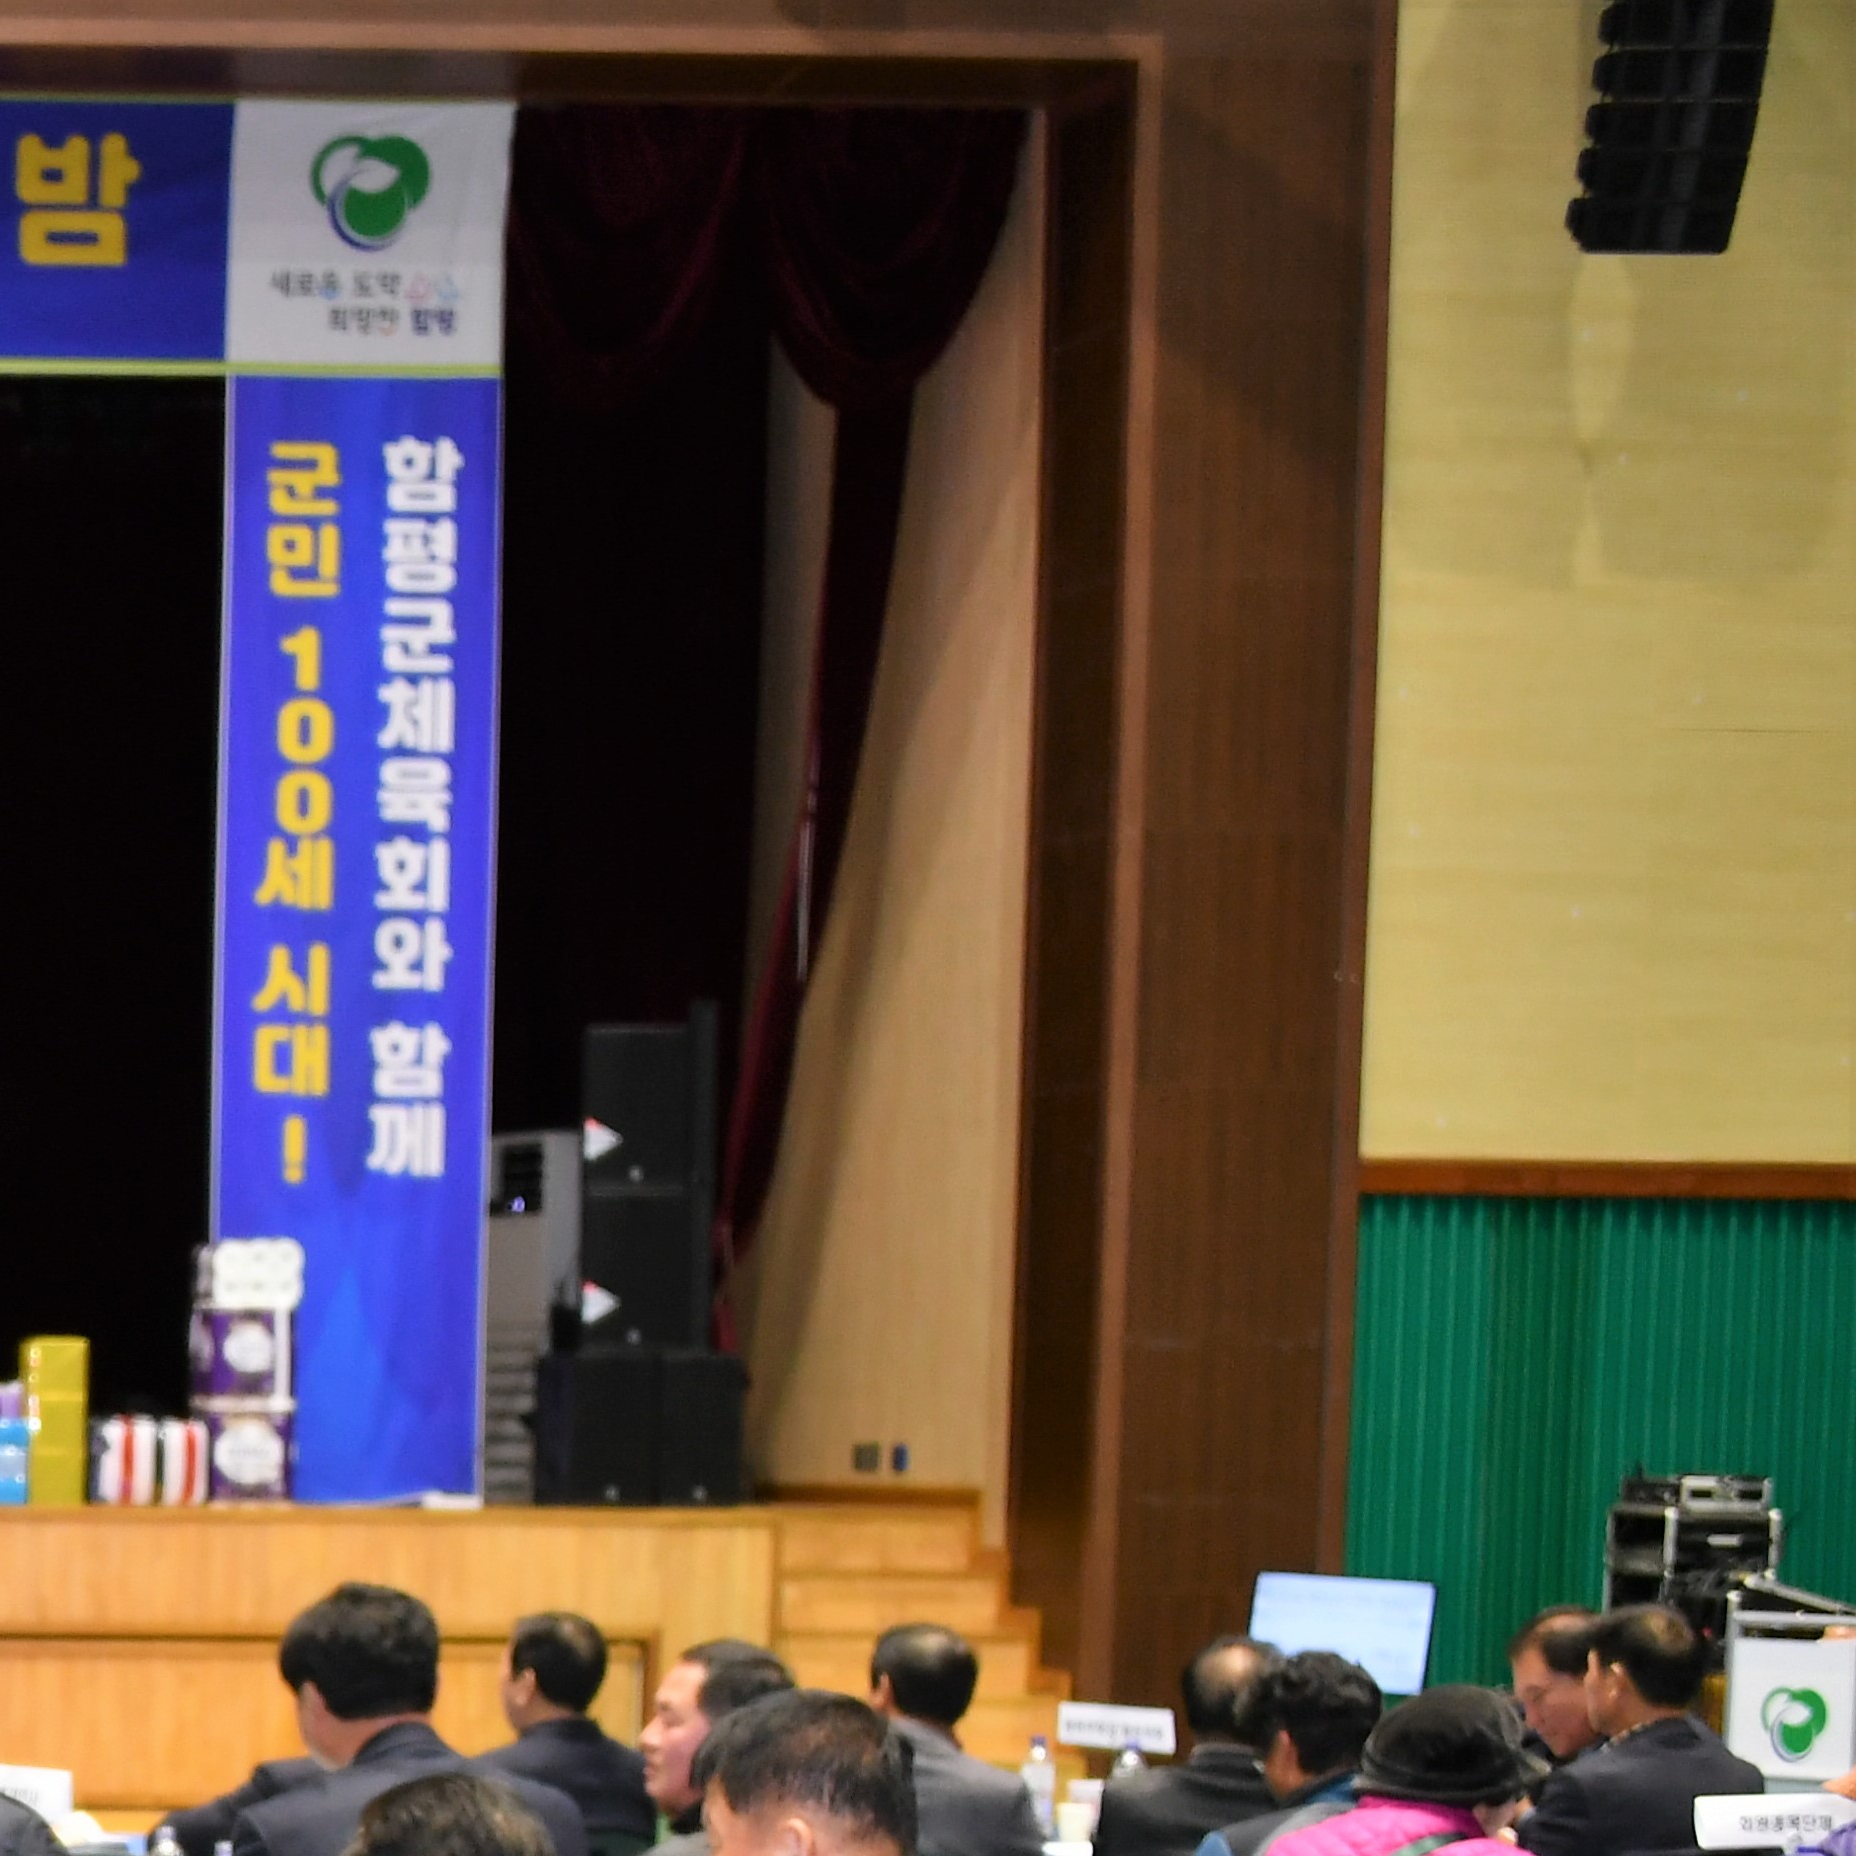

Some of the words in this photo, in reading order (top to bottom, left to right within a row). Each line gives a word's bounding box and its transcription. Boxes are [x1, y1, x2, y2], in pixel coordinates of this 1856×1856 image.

[14, 131, 142, 268] 밤
[265, 440, 342, 599] 군민
[252, 625, 336, 912] 100세
[370, 435, 465, 994] 함평군체육회와
[251, 942, 332, 1098] 시대
[365, 1020, 453, 1179] 함께
